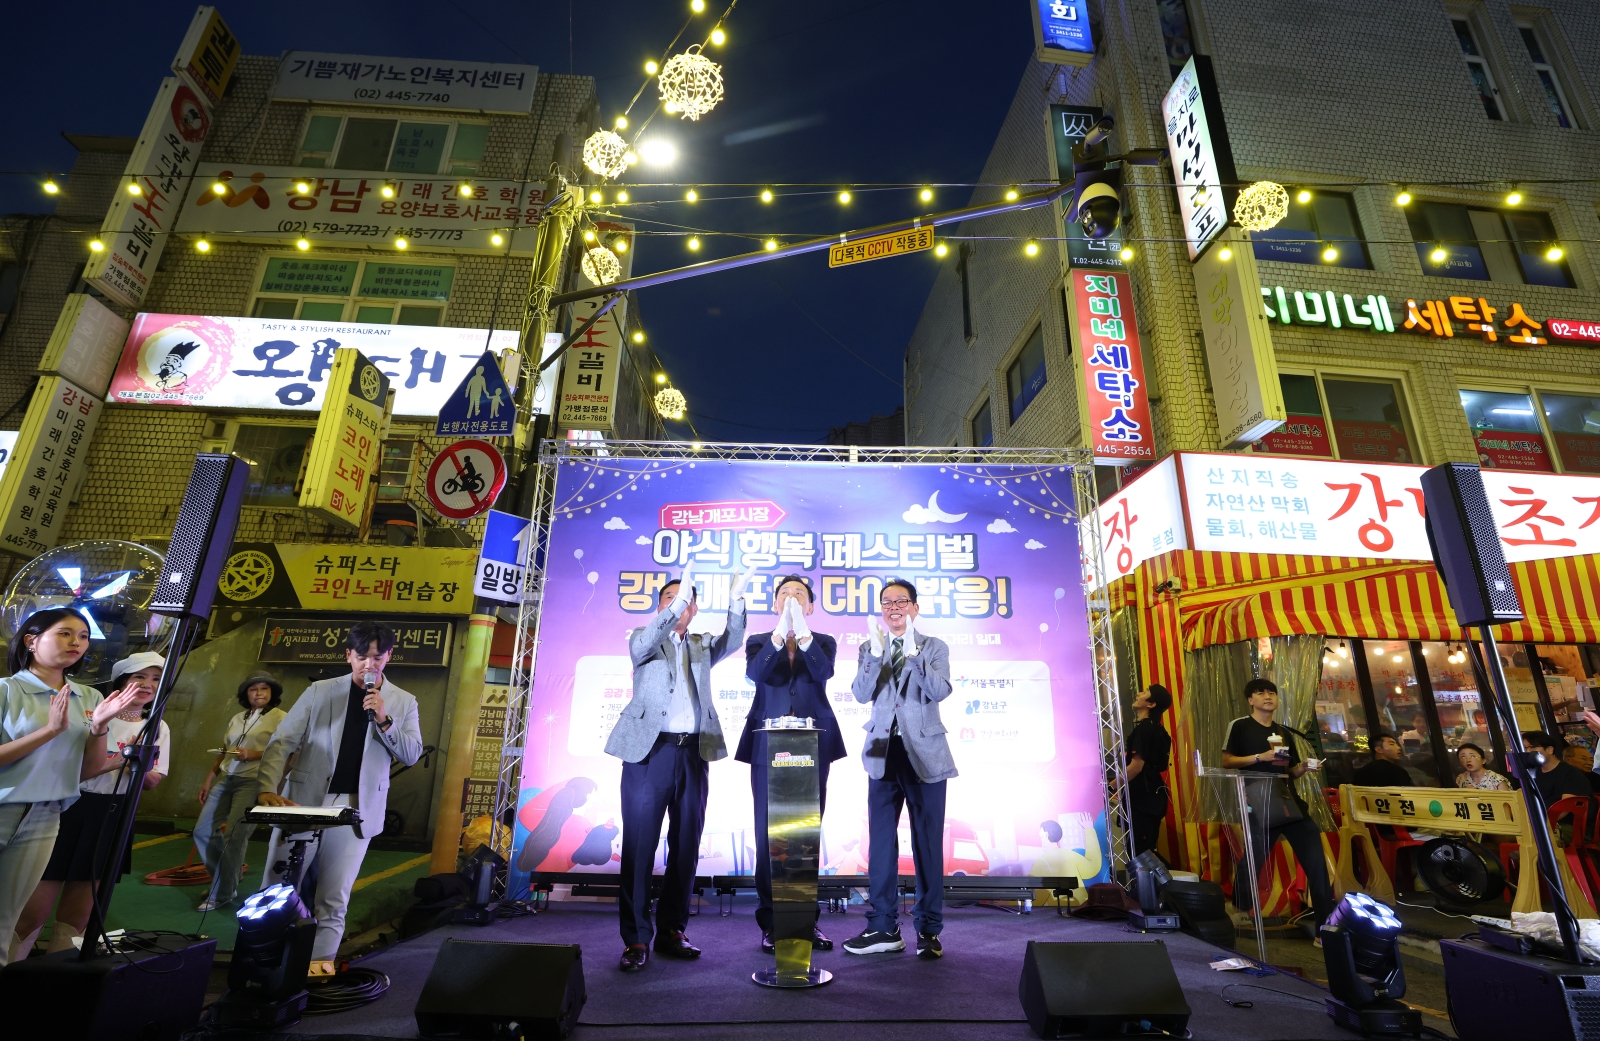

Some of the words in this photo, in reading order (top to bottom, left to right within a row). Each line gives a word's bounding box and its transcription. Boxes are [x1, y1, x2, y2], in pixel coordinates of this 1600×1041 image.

[199, 19, 236, 87] 권투
[290, 59, 525, 90] 기쁨재가노인복지센터
[353, 87, 381, 100] (02)
[385, 89, 450, 103] 445-7740
[1168, 85, 1199, 137] 을지로
[285, 176, 371, 215] 강남
[376, 200, 542, 225] 요양보호사교육원
[277, 219, 307, 233] (02)
[312, 221, 380, 238] 579-7723
[393, 226, 464, 241] 445-7773
[834, 245, 865, 261] 다목적
[867, 240, 894, 257] CCTV
[896, 232, 928, 250] 작동중
[109, 263, 144, 296] 가맹점문의
[377, 266, 442, 278] 병원코디네이터
[1084, 273, 1127, 341] 지미네
[261, 323, 288, 332] TASTY
[290, 324, 297, 332] &
[299, 324, 335, 334] STYLISH
[336, 327, 391, 336] RESTAURANT
[1403, 295, 1548, 346] 세탁소
[577, 351, 606, 392] 갈비
[61, 386, 95, 417] 강남
[1087, 343, 1143, 443] 세탁소
[345, 402, 378, 436] 슈퍼스타
[564, 404, 608, 414] 가맹점문의
[440, 420, 509, 433] 보행자전용도로
[342, 424, 372, 464] 코인
[1096, 444, 1152, 456] 445-2554
[1511, 440, 1543, 453] 세탁소
[20, 409, 69, 522] 미래간호학원
[40, 418, 86, 529] 요양보호사교육원
[334, 456, 365, 493] 노래
[1206, 467, 1298, 489] 산지직송
[1205, 492, 1266, 513] 자연산
[1270, 496, 1310, 515] 막회
[671, 506, 770, 526] 강남개포시장
[23, 525, 38, 540] 3층
[1152, 527, 1174, 551] 본점
[1205, 517, 1253, 540] 물회,
[1257, 520, 1318, 541] 해산물
[5, 533, 48, 555] 445-7773
[653, 529, 731, 567] 야식
[738, 530, 816, 569] 행복
[821, 532, 975, 570] 페스티벌
[233, 553, 249, 562] COIN
[250, 553, 271, 568] SINGING
[314, 554, 400, 576] 슈퍼스타
[282, 635, 319, 648] 성지교회
[976, 633, 1001, 646] 일대
[604, 687, 626, 698] 공감
[719, 689, 739, 700] 화합
[970, 679, 1015, 689] 서울특별시
[834, 692, 853, 702] 감동
[981, 701, 1007, 710] 강남구
[1374, 798, 1416, 817] 안전
[1454, 801, 1496, 822] 제일
